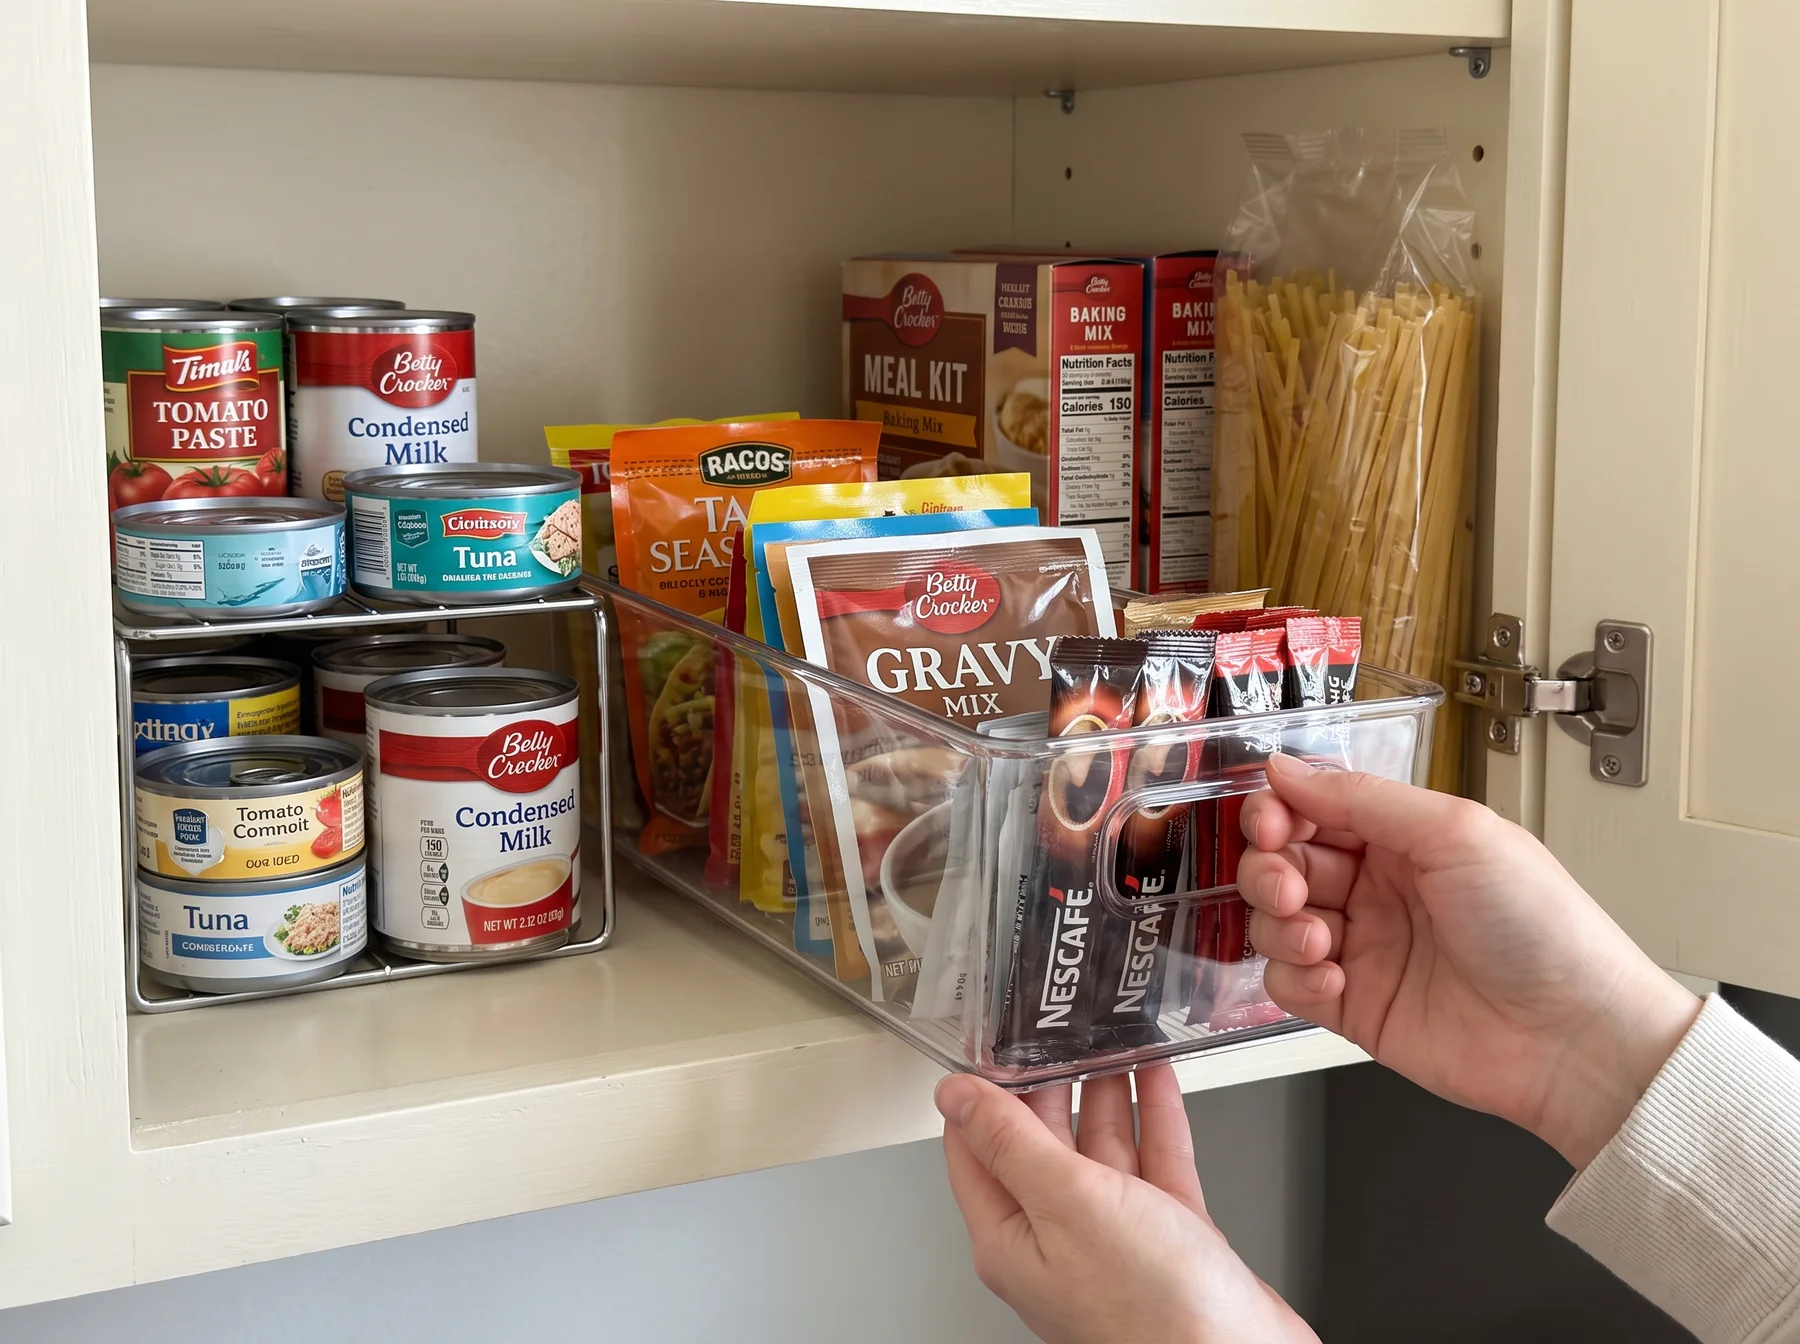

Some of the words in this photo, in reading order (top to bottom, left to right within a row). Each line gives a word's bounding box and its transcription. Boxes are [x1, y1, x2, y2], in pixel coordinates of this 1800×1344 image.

[902, 285, 932, 312] Betty
[1070, 306, 1126, 322] BAKING
[1085, 325, 1112, 341] MIX
[1187, 321, 1216, 336] MIX
[394, 351, 442, 377] Betty
[1062, 358, 1104, 369] Nutrition
[1106, 357, 1132, 368] Facts
[1164, 352, 1206, 364] Nutrition
[379, 371, 450, 395] Crocker
[864, 353, 922, 399] MEAL
[929, 360, 968, 404] KIT
[153, 399, 269, 423] TOMATO
[1062, 401, 1103, 412] Calories
[1164, 396, 1205, 406] Calories
[348, 411, 469, 438] Condensed
[883, 410, 920, 435] Baking
[922, 417, 943, 435] Mix
[171, 426, 257, 450] PASTE
[385, 440, 449, 465] Milk
[707, 449, 786, 477] RACOS
[453, 546, 517, 569] Tuna
[926, 571, 978, 602] Betty
[916, 593, 988, 619] Crocker
[866, 635, 1058, 694] GRAVY
[942, 692, 1005, 718] MIX
[236, 805, 304, 822] Tomato
[455, 788, 576, 828] Condensed
[499, 825, 552, 853] Milk
[183, 905, 249, 931] Tuna
[483, 920, 501, 932] NET
[503, 918, 518, 930] WT
[519, 915, 535, 928] 2.12
[884, 960, 905, 978] NET
